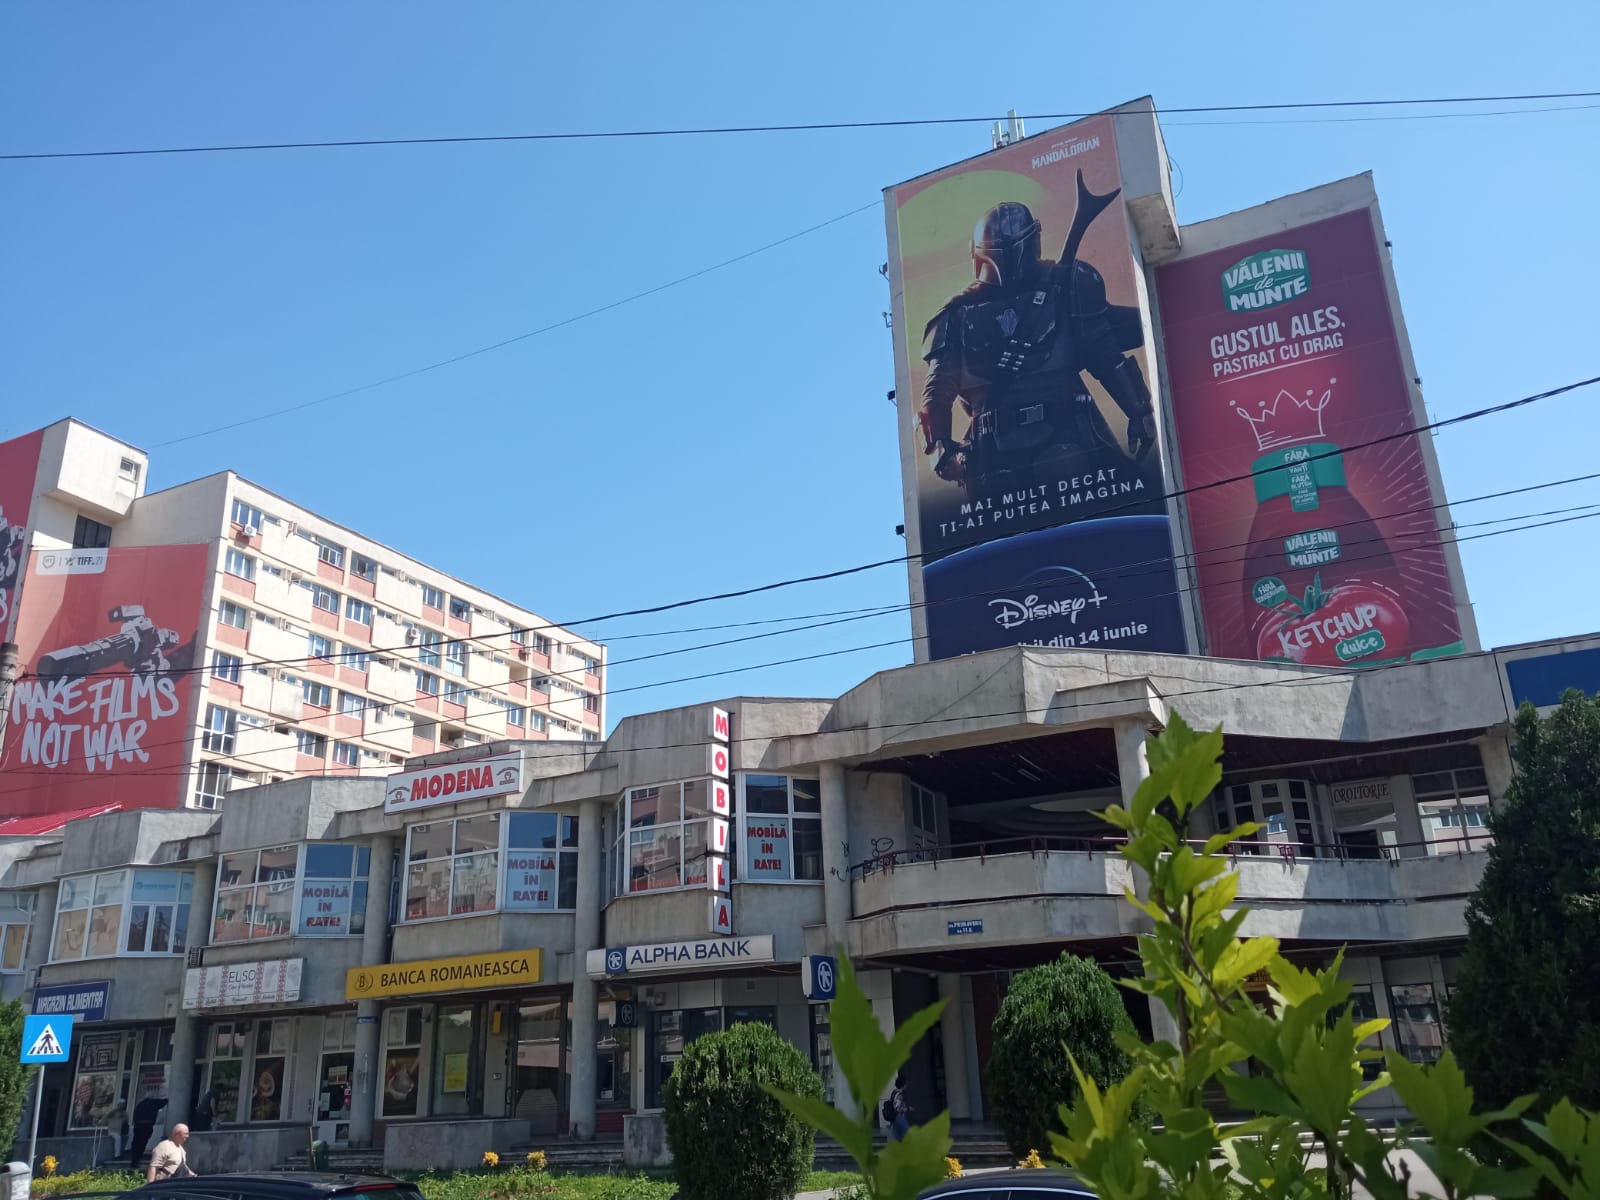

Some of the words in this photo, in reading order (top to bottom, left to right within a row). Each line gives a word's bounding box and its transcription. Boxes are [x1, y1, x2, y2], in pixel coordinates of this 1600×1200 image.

[1031, 136, 1100, 168] MANDALORIAN
[1224, 252, 1305, 289] VĂLENII
[1254, 276, 1274, 291] de
[1229, 275, 1308, 311] MUNTE
[1210, 320, 1286, 359] GUSTUL
[1212, 349, 1276, 378] PĂSTRAT
[1279, 343, 1300, 361] CU
[1302, 332, 1344, 355] DRAG
[961, 498, 992, 515] MAI
[1002, 484, 1048, 504] MULT
[1058, 468, 1116, 492] DECÂT
[994, 500, 1050, 522] PUTEA
[1060, 478, 1145, 507] IMAGINA
[1289, 546, 1340, 566] MUNTE
[1048, 634, 1075, 648] din
[1079, 629, 1100, 645] 14
[1103, 621, 1149, 641] iunie
[1277, 605, 1377, 653] KETCHUP
[1341, 634, 1379, 656] dulce
[12, 674, 88, 725] MAKE
[88, 669, 180, 723] FILMS
[21, 721, 81, 769] NOT
[84, 719, 149, 773] WAR
[410, 765, 494, 801] MODENA
[714, 713, 729, 928] MOBILA
[753, 858, 782, 871] RATE!
[513, 890, 549, 902] RATE!
[306, 916, 341, 927] RATE!
[631, 948, 691, 965] ALPHA
[694, 940, 751, 960] BANK
[380, 969, 426, 987] BANCA
[430, 959, 530, 983] ROMANEASCA
[36, 995, 68, 1014] MAGAZIN
[66, 991, 105, 1011] ALIMENTAR
